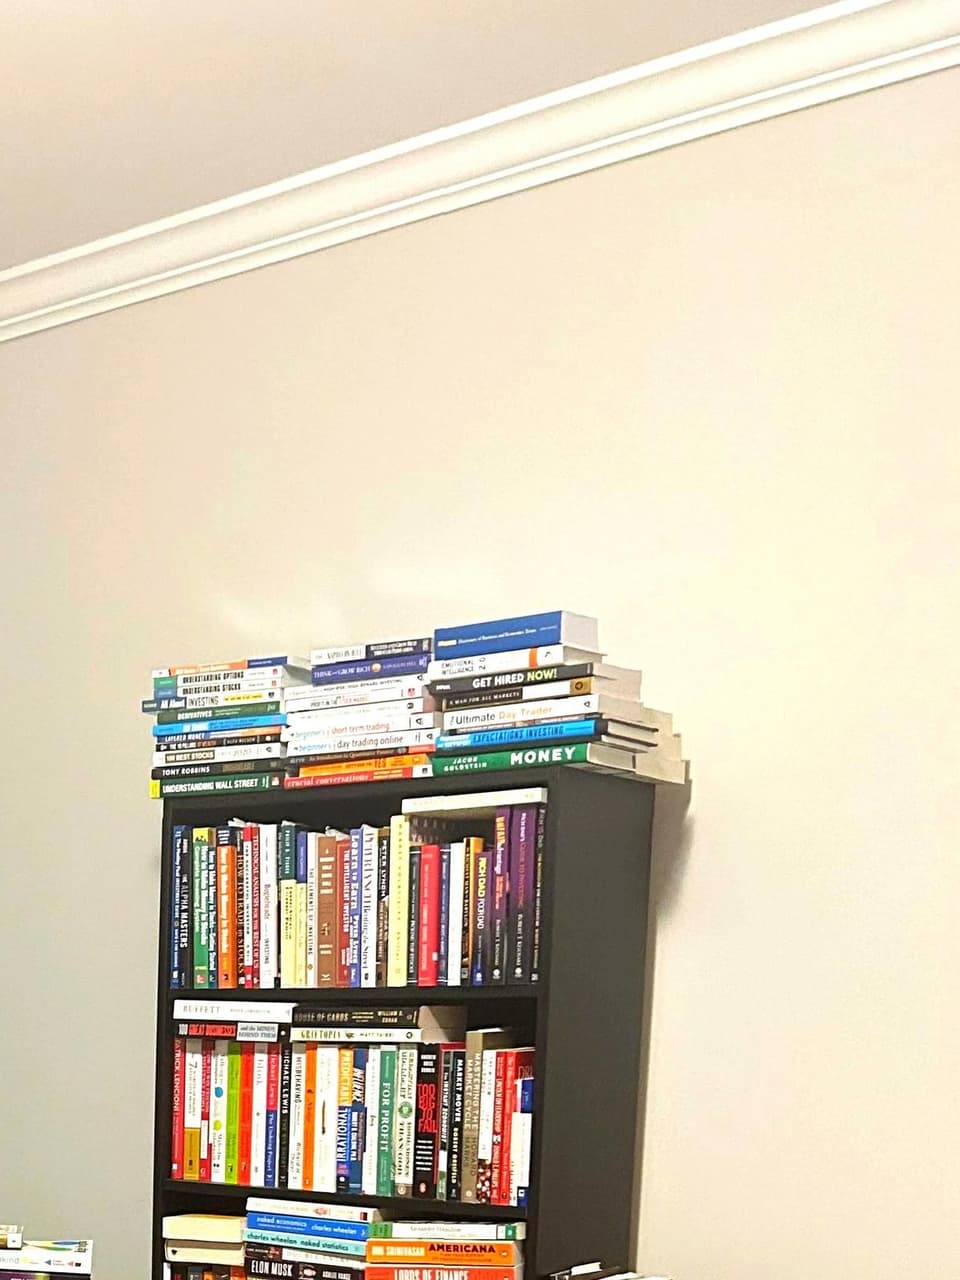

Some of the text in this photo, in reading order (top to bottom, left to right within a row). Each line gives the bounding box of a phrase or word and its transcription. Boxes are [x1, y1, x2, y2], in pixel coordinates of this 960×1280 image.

[473, 669, 557, 688] GET HIRED NOW!
[188, 696, 218, 706] INVESTING
[456, 706, 552, 725] Ultimate Day Trader
[337, 735, 403, 749] day trading online
[511, 747, 576, 765] MONEY
[162, 767, 210, 776] TONY ROBBINS
[163, 778, 258, 793] UNDERSTANDING WALL STREET
[454, 1059, 463, 1122] MARKET MOVER
[380, 1082, 391, 1152] FOR PROFIT
[429, 1244, 495, 1253] AMERICANA
[251, 1260, 293, 1276] ELON MUSK
